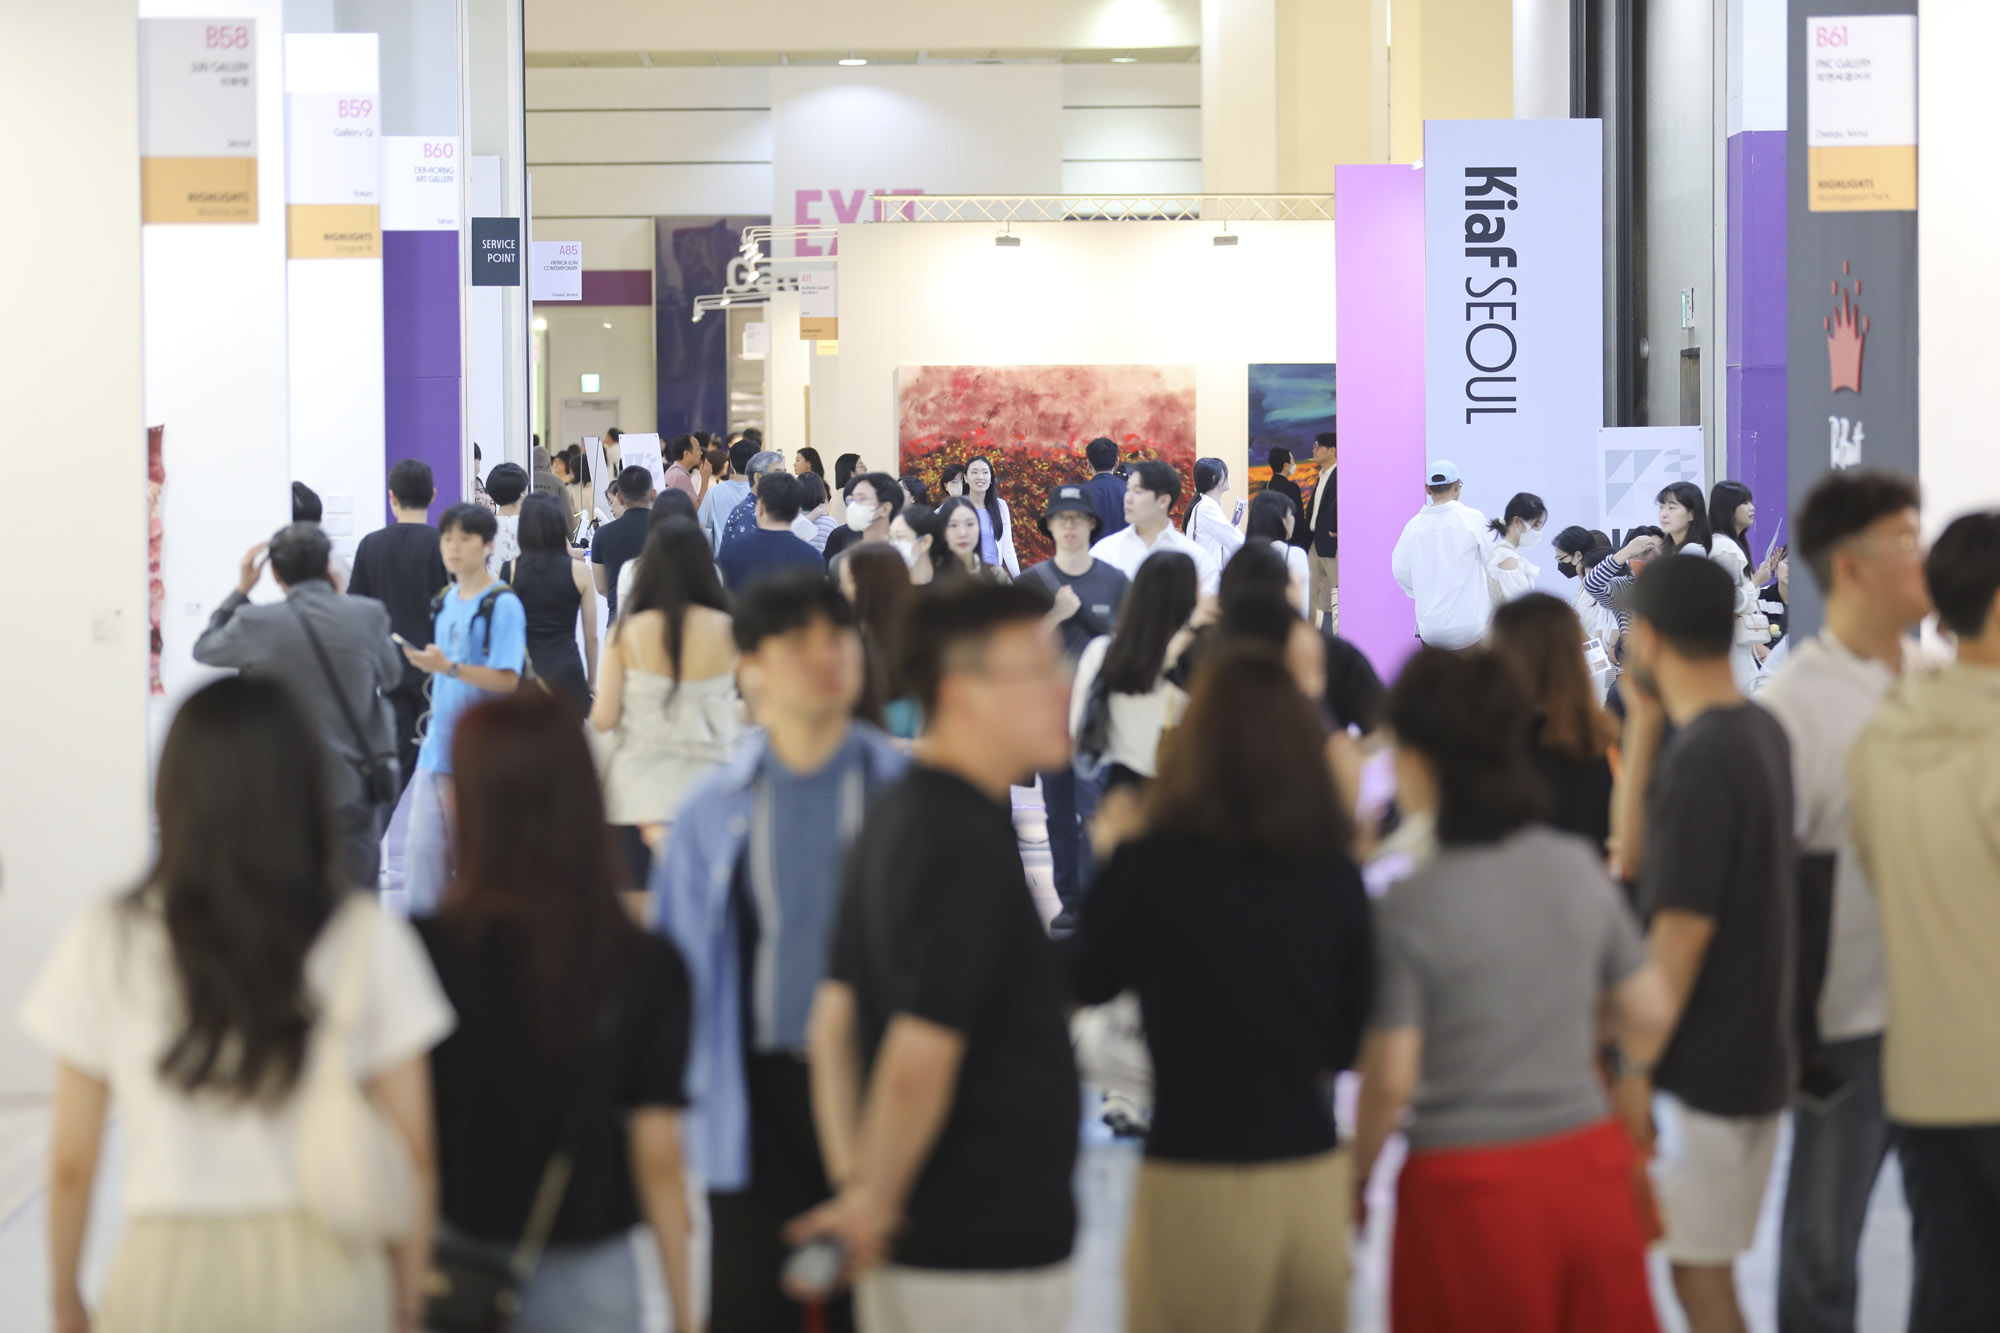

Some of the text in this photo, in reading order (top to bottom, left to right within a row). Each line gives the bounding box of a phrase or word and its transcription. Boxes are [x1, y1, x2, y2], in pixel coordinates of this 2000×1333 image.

[205, 25, 250, 49] B58
[1815, 26, 1849, 48] B61
[338, 99, 373, 118] B59
[333, 128, 363, 138] Gallery
[424, 143, 454, 158] B60
[482, 239, 516, 249] SERVICE
[559, 245, 578, 256] A85
[487, 253, 516, 263] POINT
[1465, 276, 1518, 425] SEOUL
